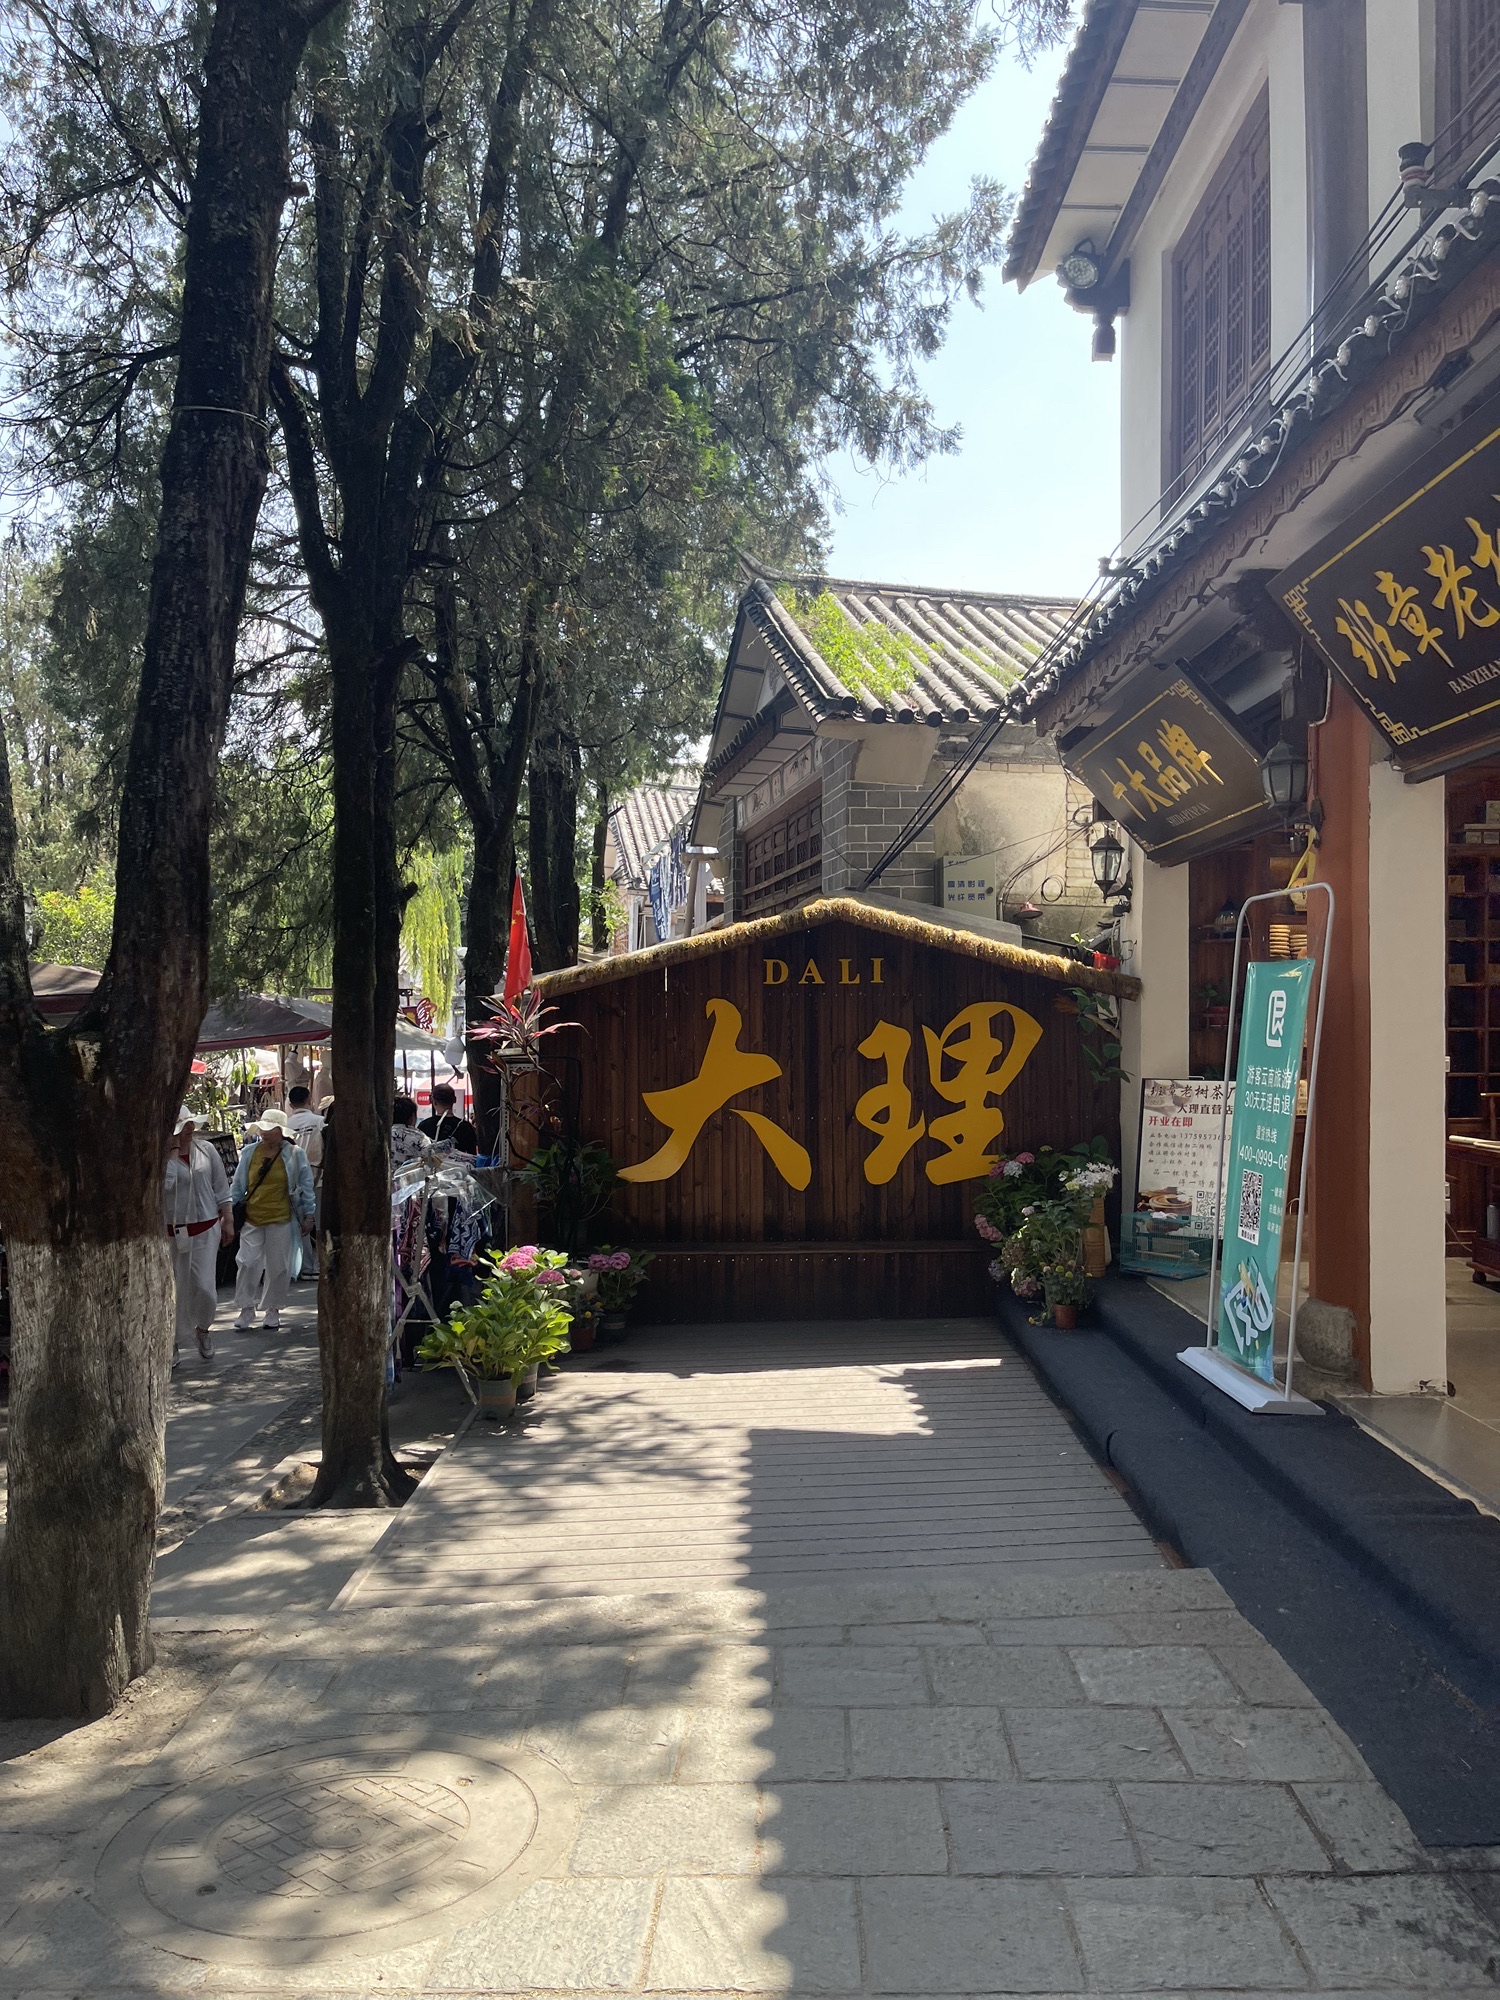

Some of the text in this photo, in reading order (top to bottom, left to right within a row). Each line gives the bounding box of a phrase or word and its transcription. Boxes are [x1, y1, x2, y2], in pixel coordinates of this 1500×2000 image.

[1448, 658, 1500, 694] BANZHA
[763, 957, 885, 985] DALI
[616, 998, 1043, 1191] 大理
[1244, 1091, 1295, 1116] 30天无理由退
[1148, 1116, 1193, 1127] 开业在即
[1177, 1104, 1234, 1115] 大理直营店
